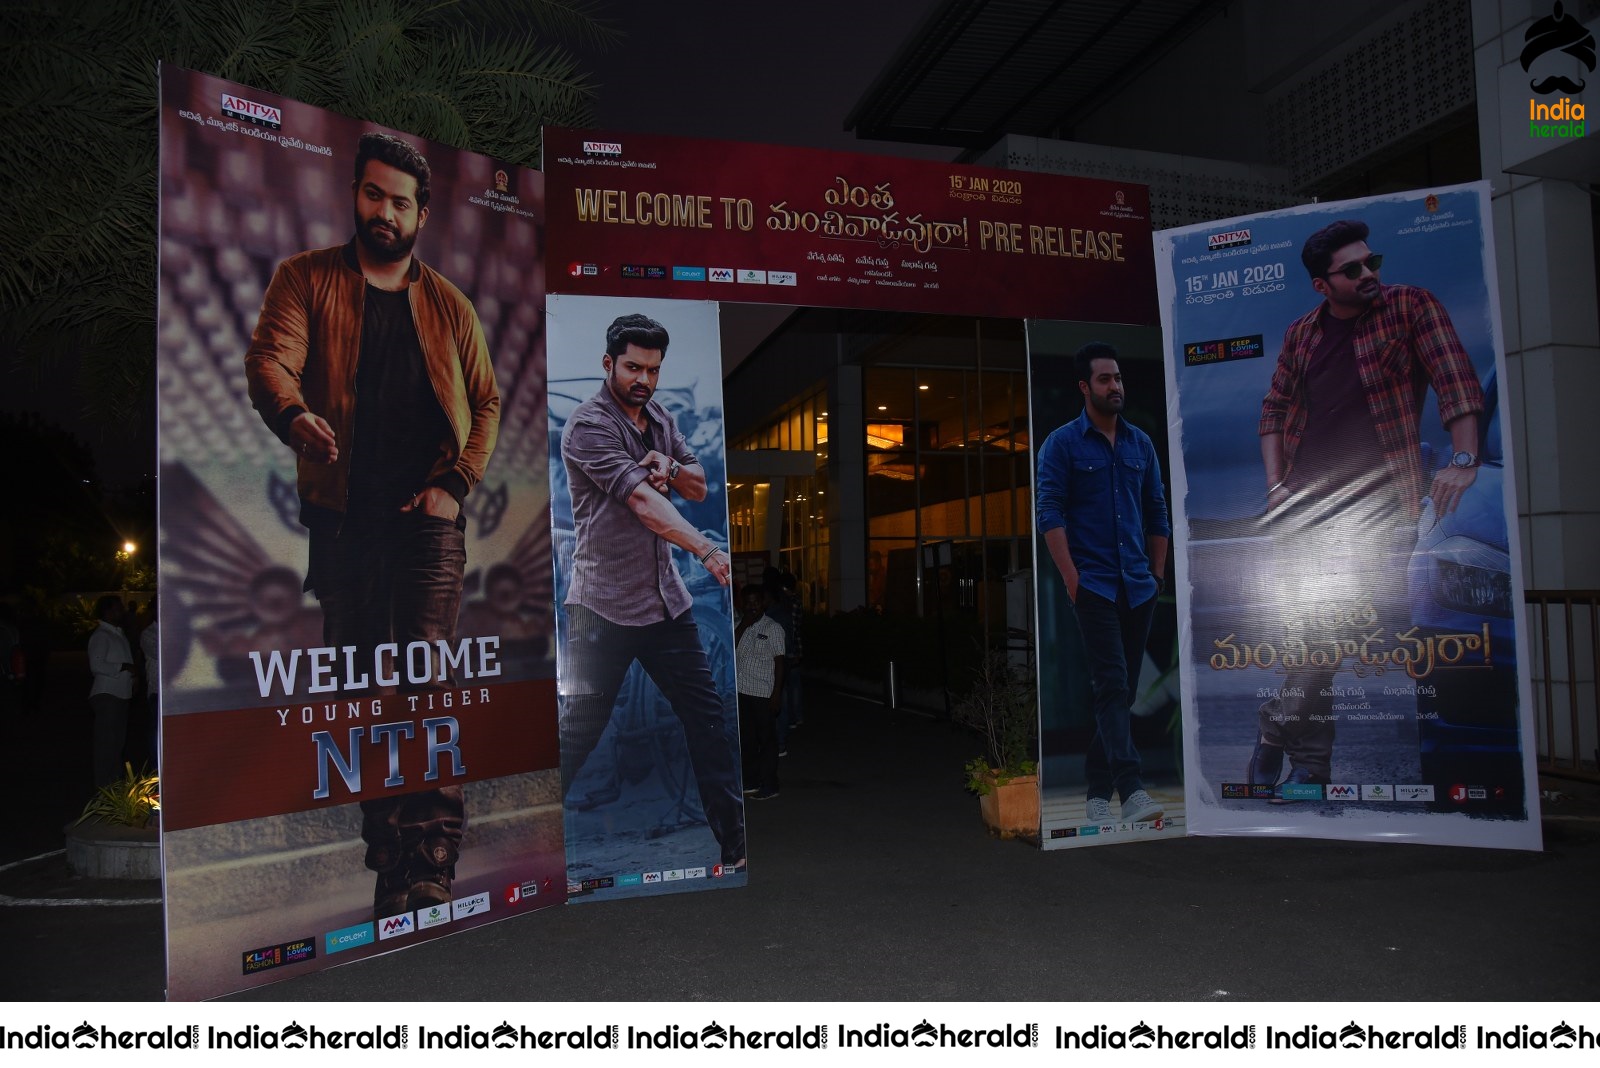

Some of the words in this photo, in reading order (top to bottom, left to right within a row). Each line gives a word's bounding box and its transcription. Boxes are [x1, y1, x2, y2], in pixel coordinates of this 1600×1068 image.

[223, 97, 280, 122] ADITYA
[226, 110, 277, 130] MUSIC
[585, 143, 621, 153] ADITYA
[824, 176, 895, 210] ఎంత
[969, 176, 990, 192] JAN
[992, 179, 1023, 196] 2020
[575, 187, 713, 229] WELCOME
[719, 196, 754, 231] TO
[979, 220, 1024, 254] PRE
[1029, 224, 1126, 263] RELEASE
[1210, 231, 1250, 246] ADITYA
[1211, 269, 1239, 290] JAN
[1243, 262, 1285, 284] 2020
[1242, 282, 1286, 297] విడుదల
[248, 635, 502, 698] WELCOME
[277, 699, 384, 727] YOUNG
[408, 687, 491, 712] TIGER
[311, 715, 468, 800] NTR
[246, 949, 274, 964] KLM
[286, 942, 305, 952] KEEP
[286, 945, 313, 957] LOVING
[246, 958, 275, 971] FASHION
